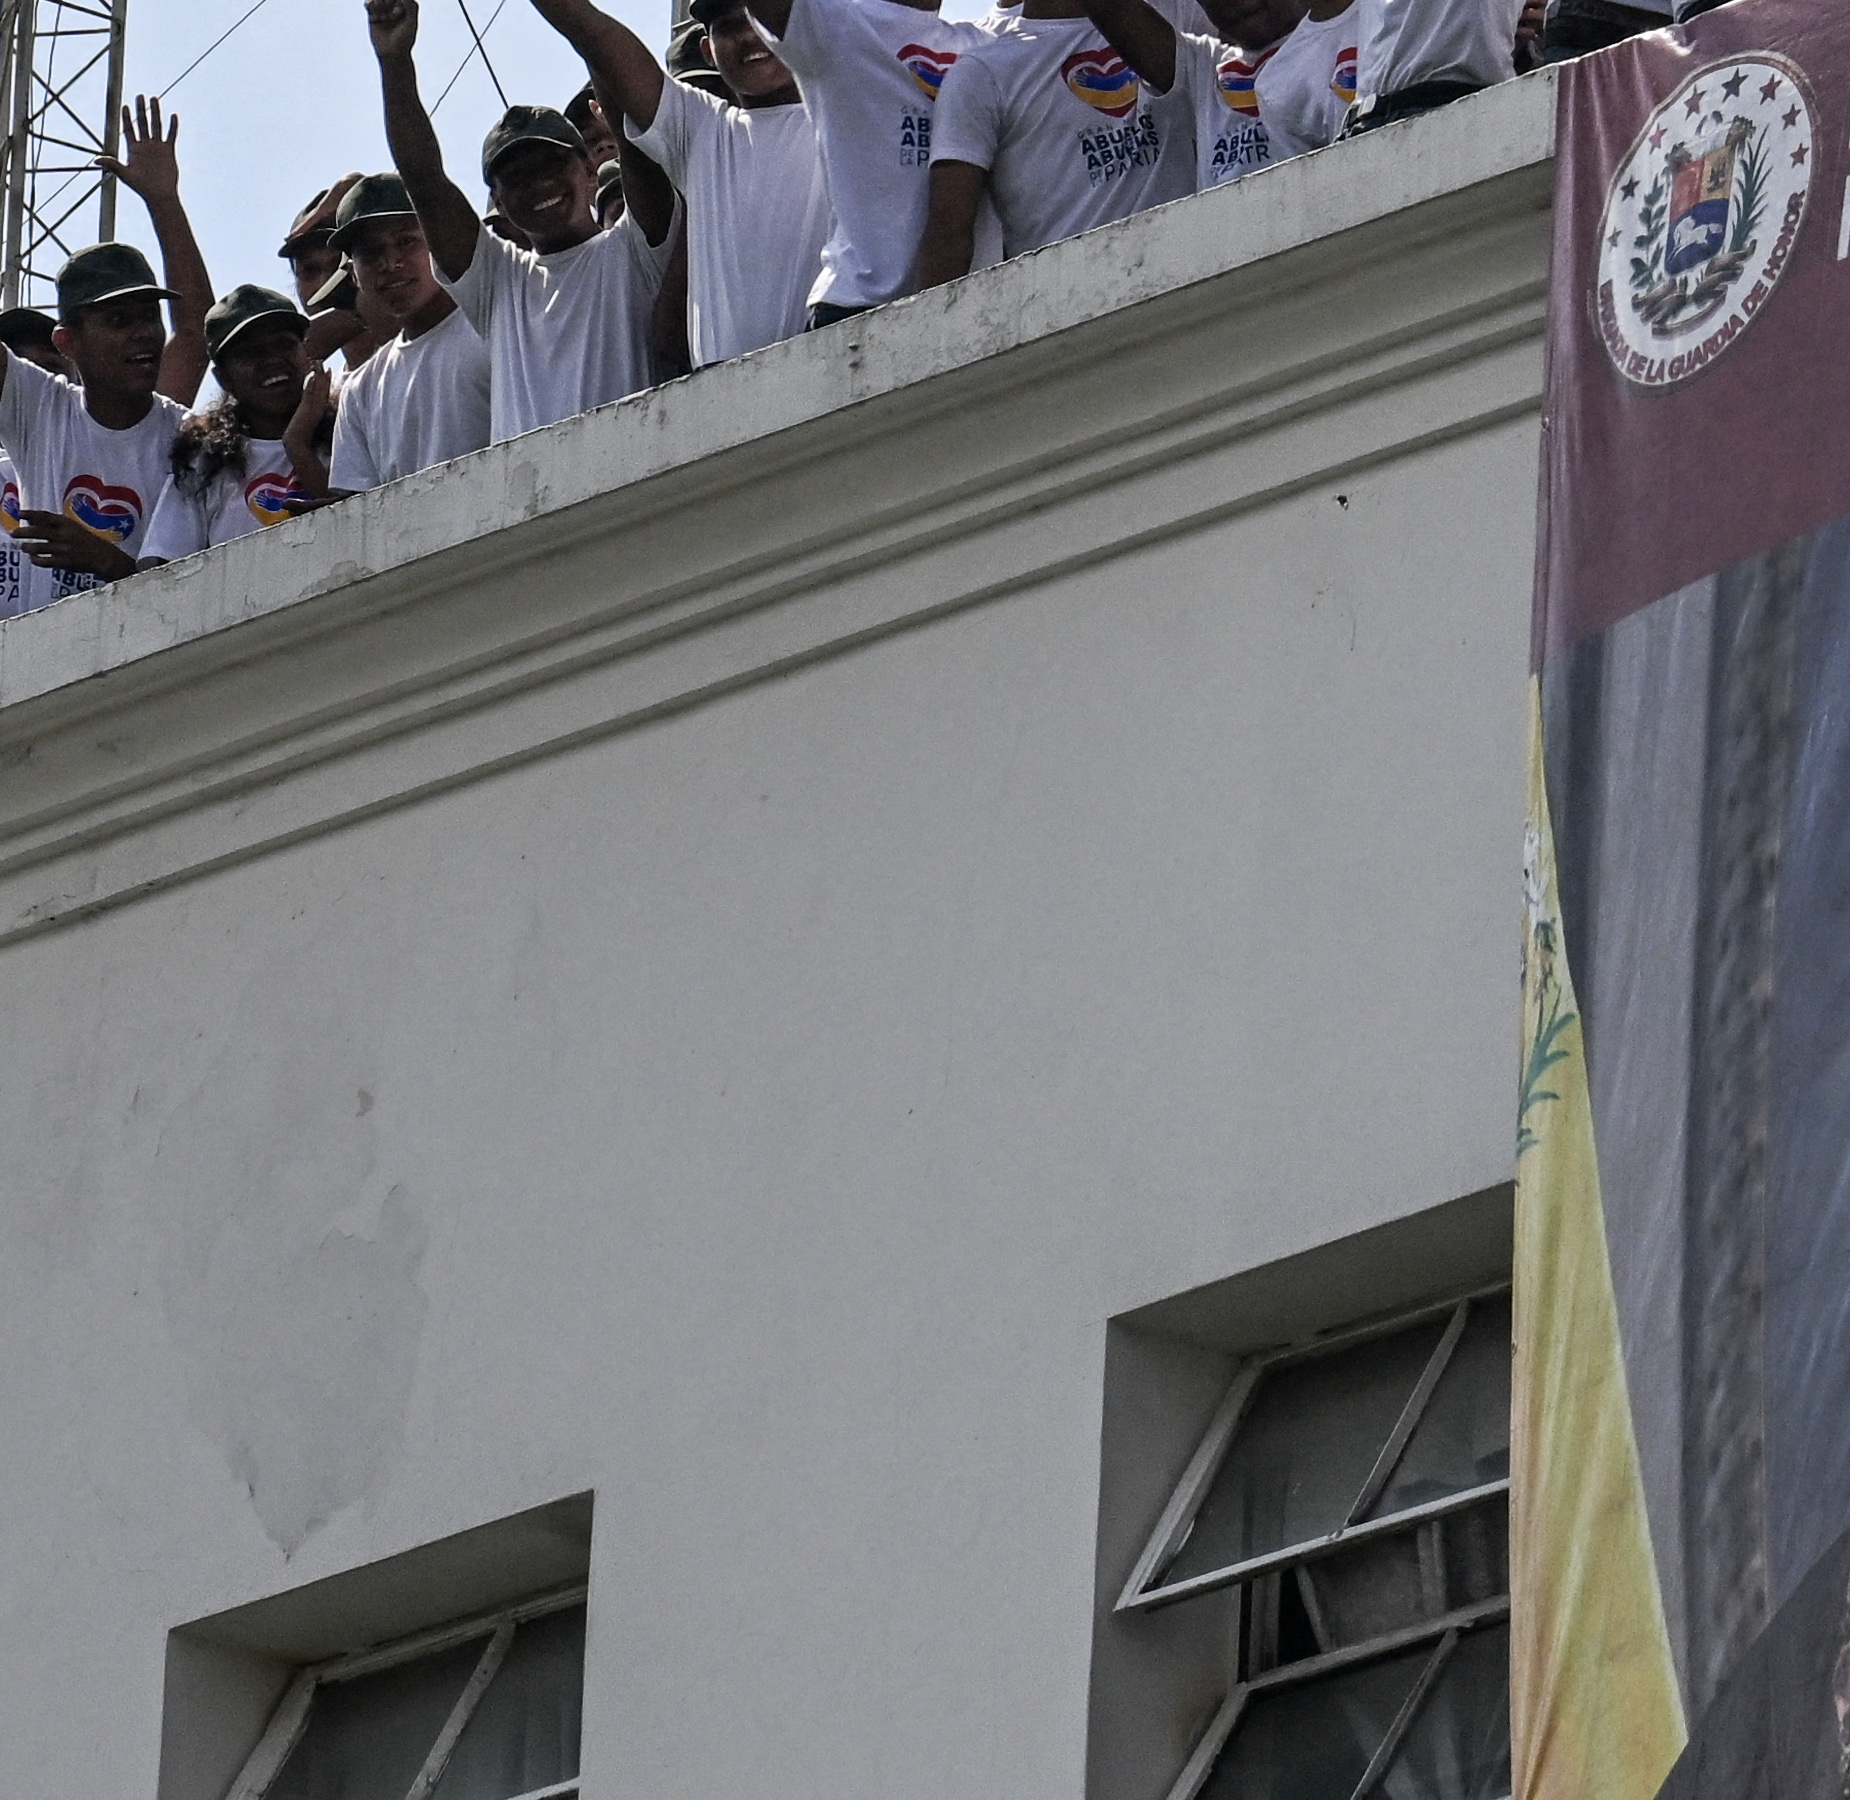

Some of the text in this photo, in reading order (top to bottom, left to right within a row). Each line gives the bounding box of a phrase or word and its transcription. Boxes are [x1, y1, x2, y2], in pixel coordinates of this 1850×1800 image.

[1105, 145, 1160, 181] PARIA
[1644, 357, 1666, 383] LA
[1668, 313, 1745, 379] GUARDIA
[1740, 279, 1769, 318] DE
[1762, 189, 1807, 281] HONOR
